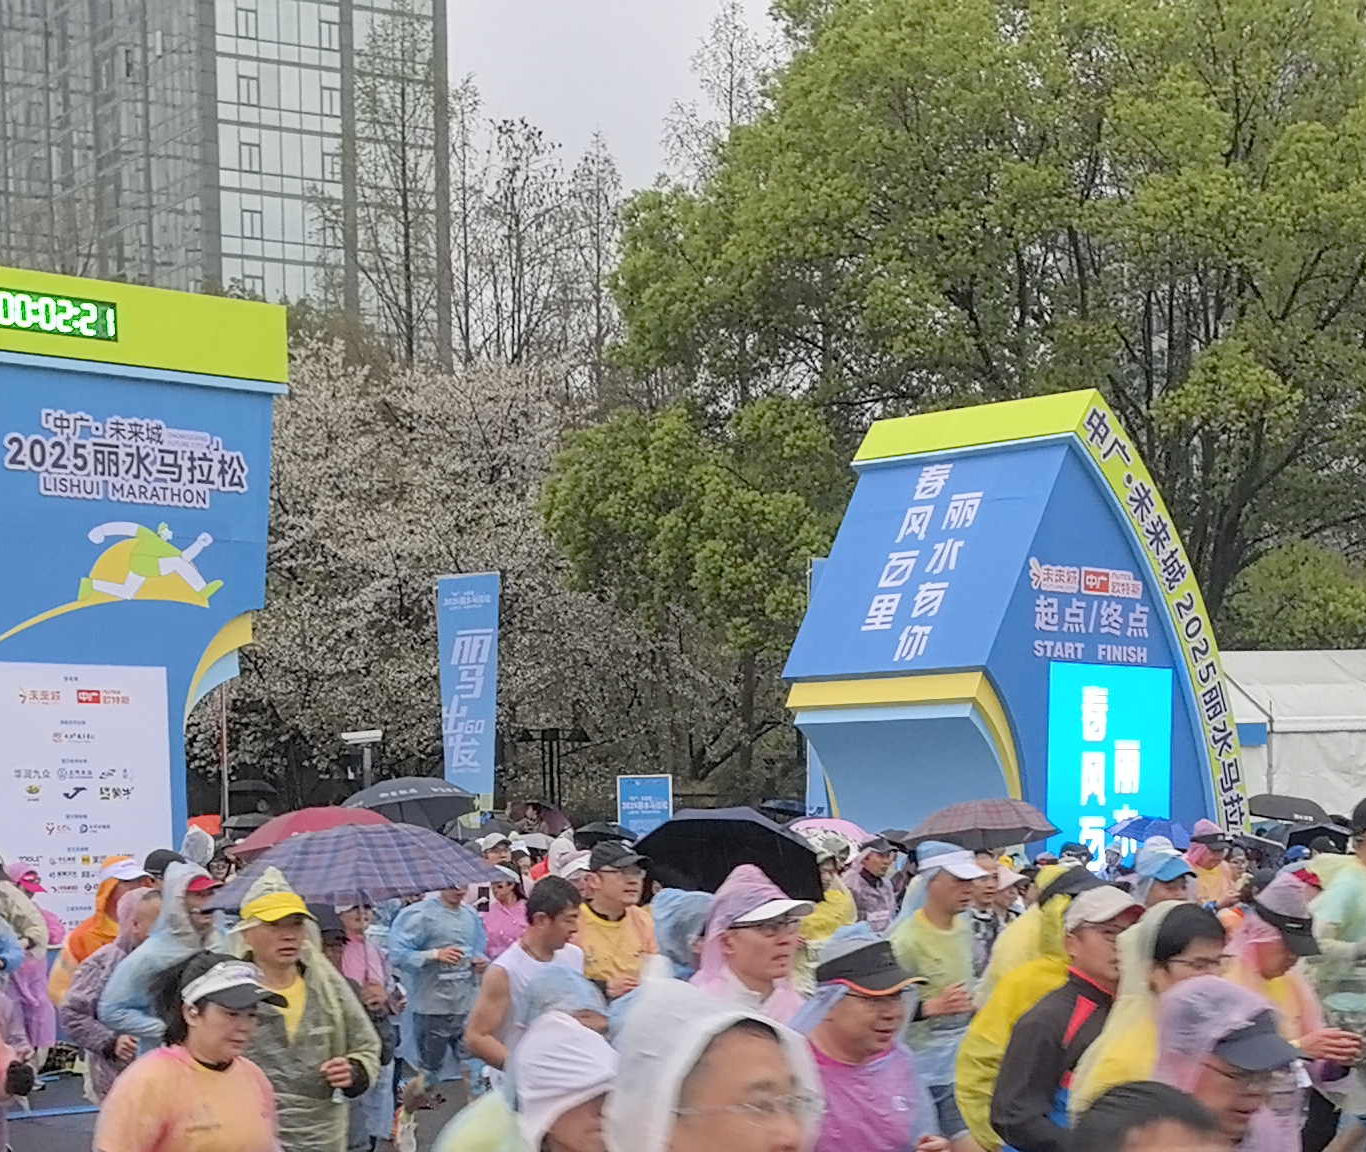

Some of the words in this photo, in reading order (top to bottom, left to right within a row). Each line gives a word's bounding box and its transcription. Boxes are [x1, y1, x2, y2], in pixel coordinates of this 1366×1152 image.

[6, 435, 246, 490] 2025丽水马拉松
[41, 476, 101, 497] LISHUI
[111, 482, 208, 504] MARATHON
[892, 490, 984, 662] 丽水有你
[1085, 574, 1108, 589] 中广
[1034, 595, 1150, 638] 起点/终点
[1033, 640, 1085, 660] START
[1097, 644, 1148, 663] FINISH
[1174, 592, 1246, 838] 2025丽水马拉
